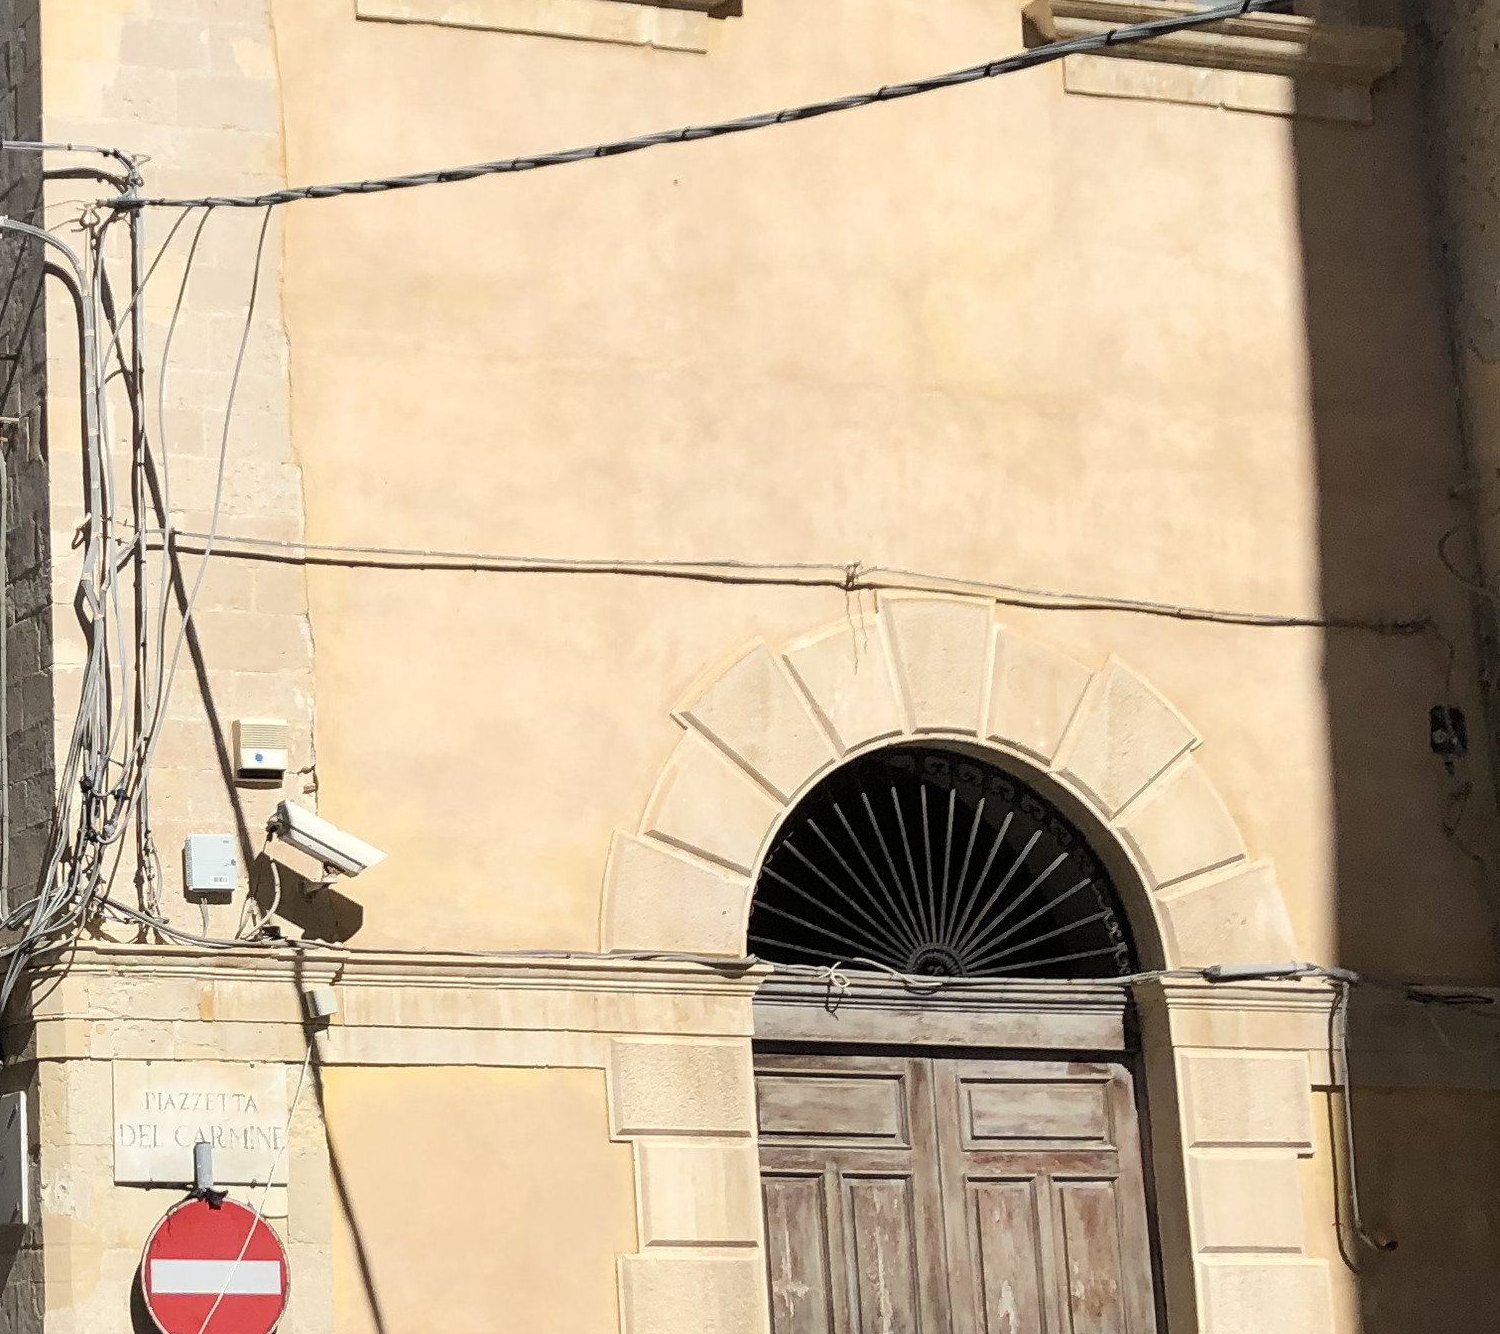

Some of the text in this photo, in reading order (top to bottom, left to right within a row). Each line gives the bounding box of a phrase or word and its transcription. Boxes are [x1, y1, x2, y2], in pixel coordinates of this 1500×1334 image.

[145, 1091, 258, 1113] PIAZZETTA
[119, 1123, 285, 1150] DEL CARMINE
